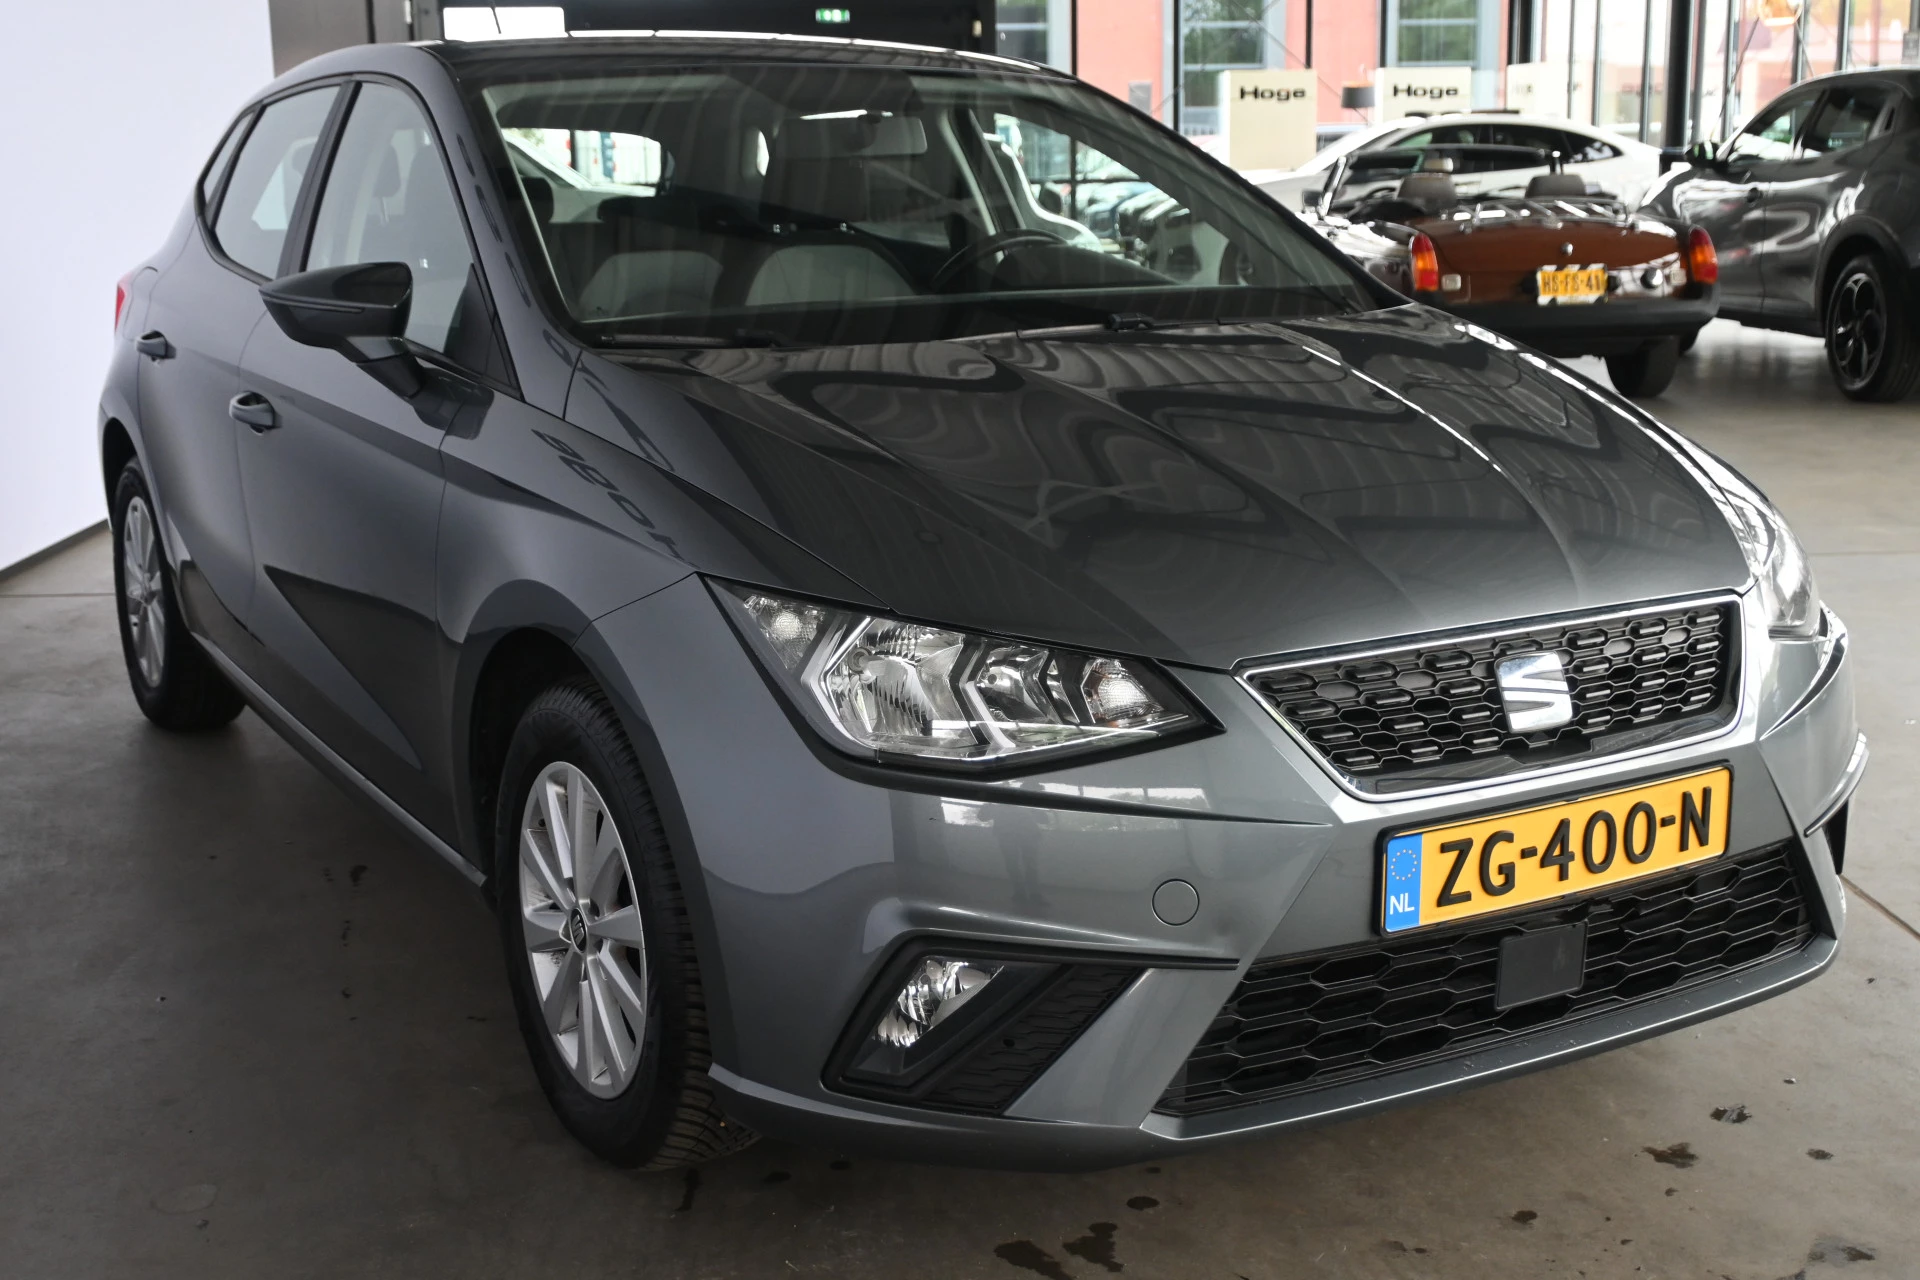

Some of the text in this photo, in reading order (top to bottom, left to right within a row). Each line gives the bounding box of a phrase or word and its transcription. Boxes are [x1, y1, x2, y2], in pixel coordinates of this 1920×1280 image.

[1239, 85, 1306, 101] Hoge
[1392, 84, 1458, 99] Hoge
[1436, 785, 1713, 909] ZG-400-N
[1389, 892, 1415, 915] NL
